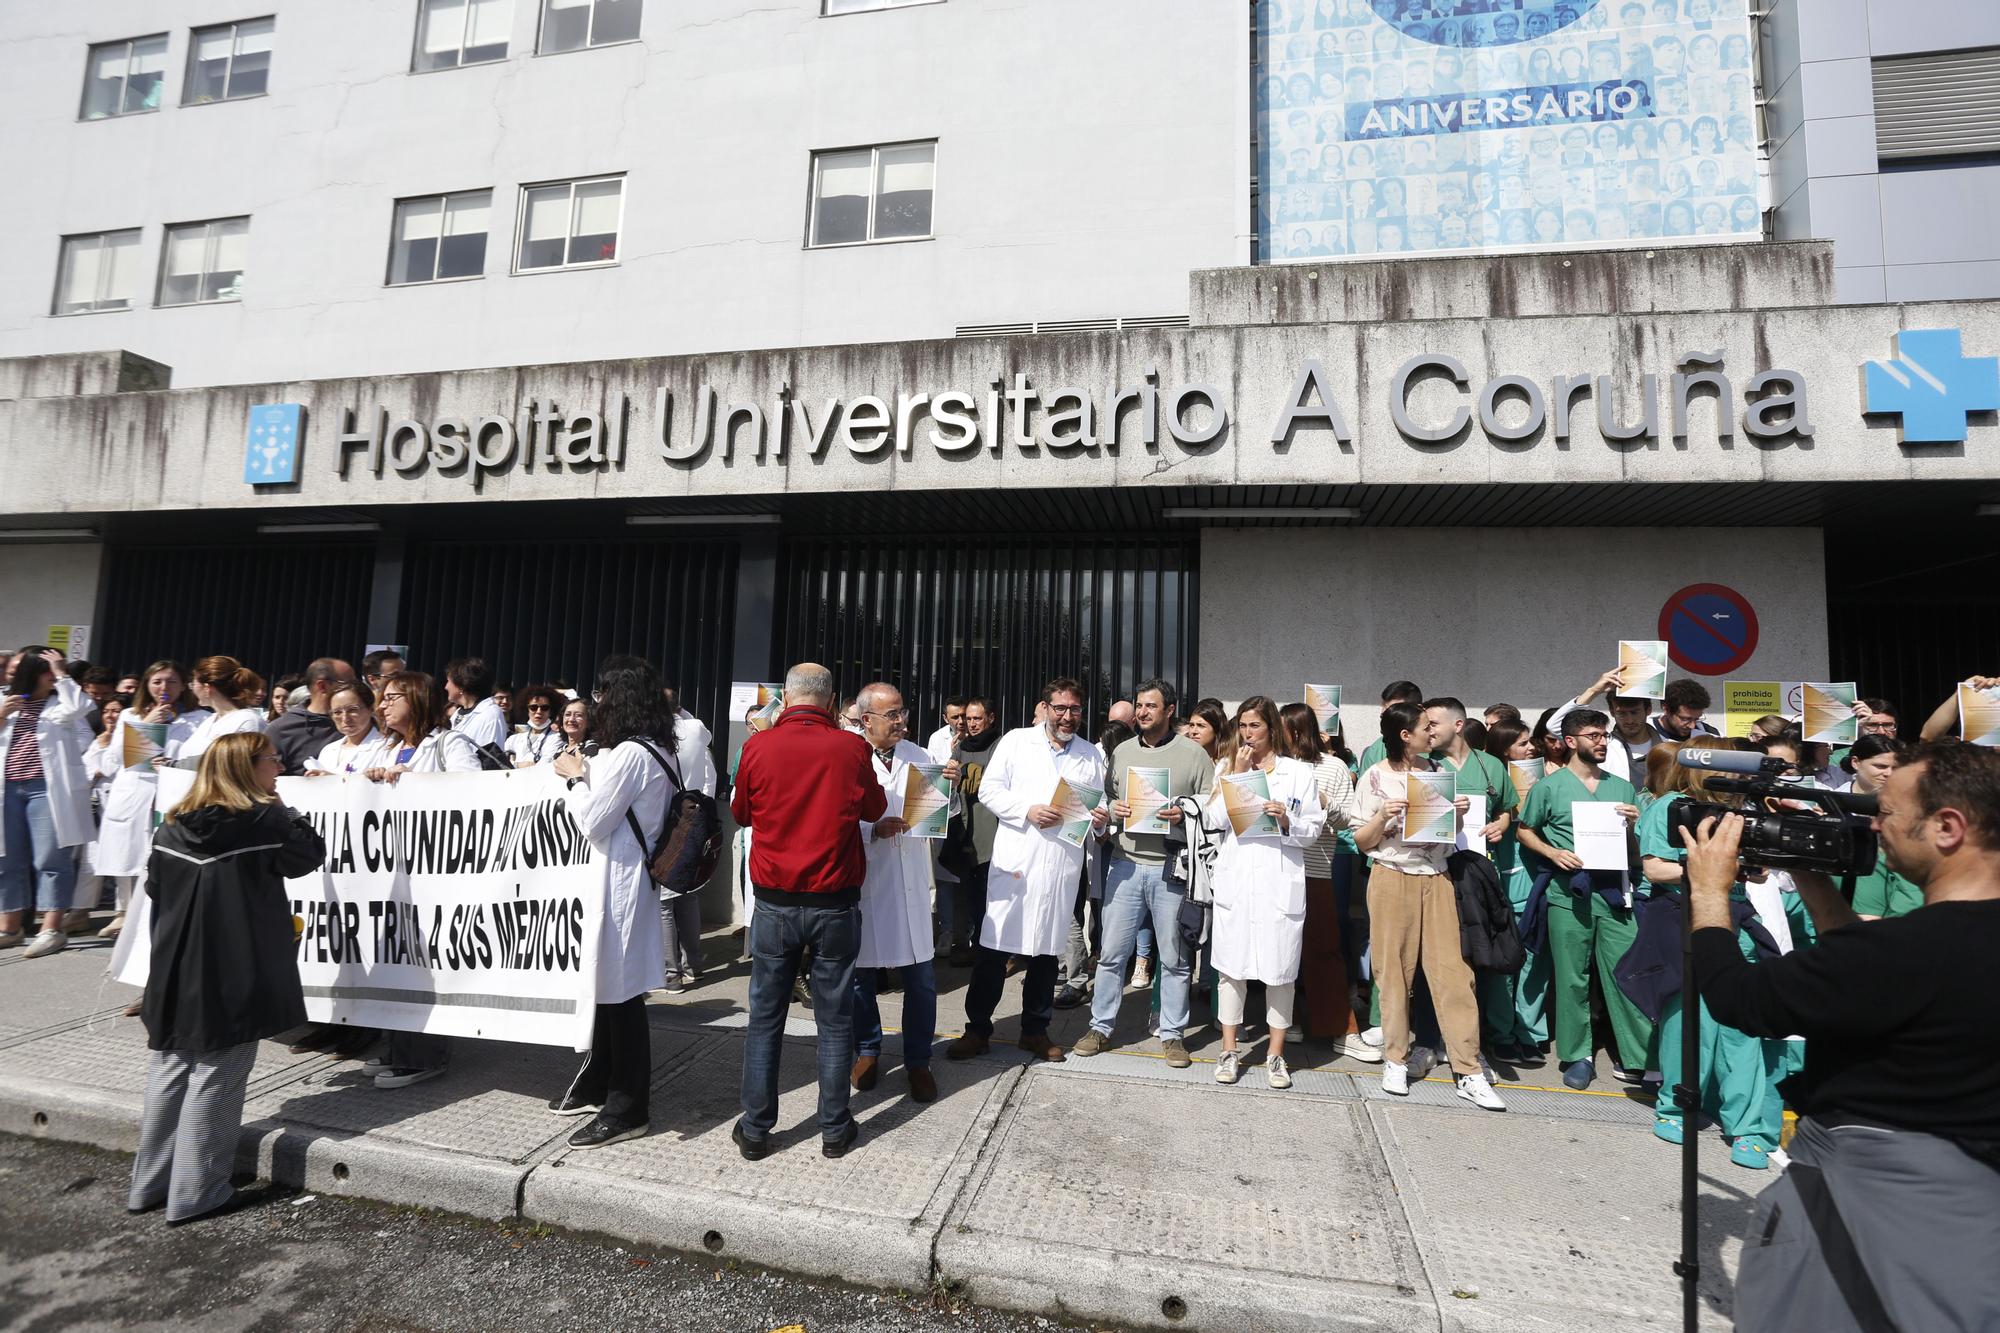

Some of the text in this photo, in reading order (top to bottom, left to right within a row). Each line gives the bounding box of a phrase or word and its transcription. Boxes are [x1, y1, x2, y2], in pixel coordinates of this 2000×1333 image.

[1359, 86, 1638, 134] ANIVERSARIO
[333, 348, 1816, 485] Hospital Universitario A Coruña
[1733, 690, 1773, 699] prohibido
[1733, 699, 1773, 707] fumar/usar
[1686, 748, 1712, 765] tve
[330, 812, 356, 873] LA
[363, 809, 494, 875] COMUNIDAD
[491, 798, 591, 873] AUTONOM
[304, 901, 362, 964] PEOR
[369, 901, 427, 968] TRATA
[429, 905, 442, 970] A
[446, 904, 492, 971] SUS
[492, 884, 584, 972] MÉDICOS
